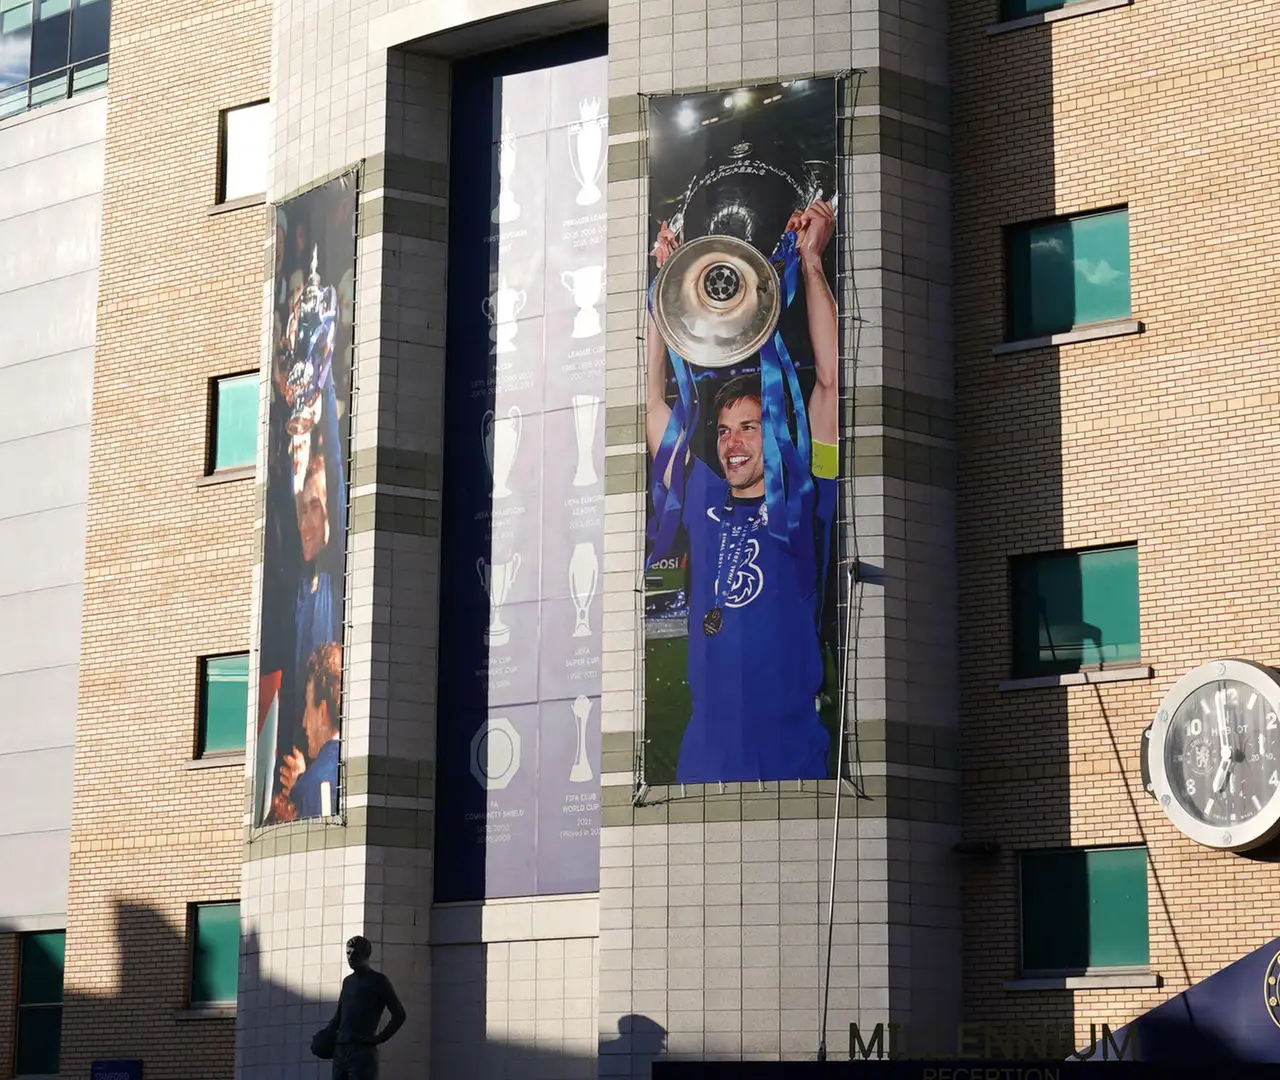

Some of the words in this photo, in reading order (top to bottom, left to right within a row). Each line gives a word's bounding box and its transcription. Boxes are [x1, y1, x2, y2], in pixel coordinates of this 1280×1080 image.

[727, 565, 737, 584] FINAL
[732, 548, 741, 564] 2021
[1184, 718, 1203, 737] 10
[1266, 712, 1277, 730] 2
[1268, 770, 1280, 787] 4
[1186, 779, 1197, 796] 8
[565, 793, 579, 802] FIFA
[580, 792, 597, 801] CLUB
[562, 804, 585, 814] WORLD
[586, 803, 600, 812] CUP
[849, 1022, 1139, 1060] MILLENNIUM
